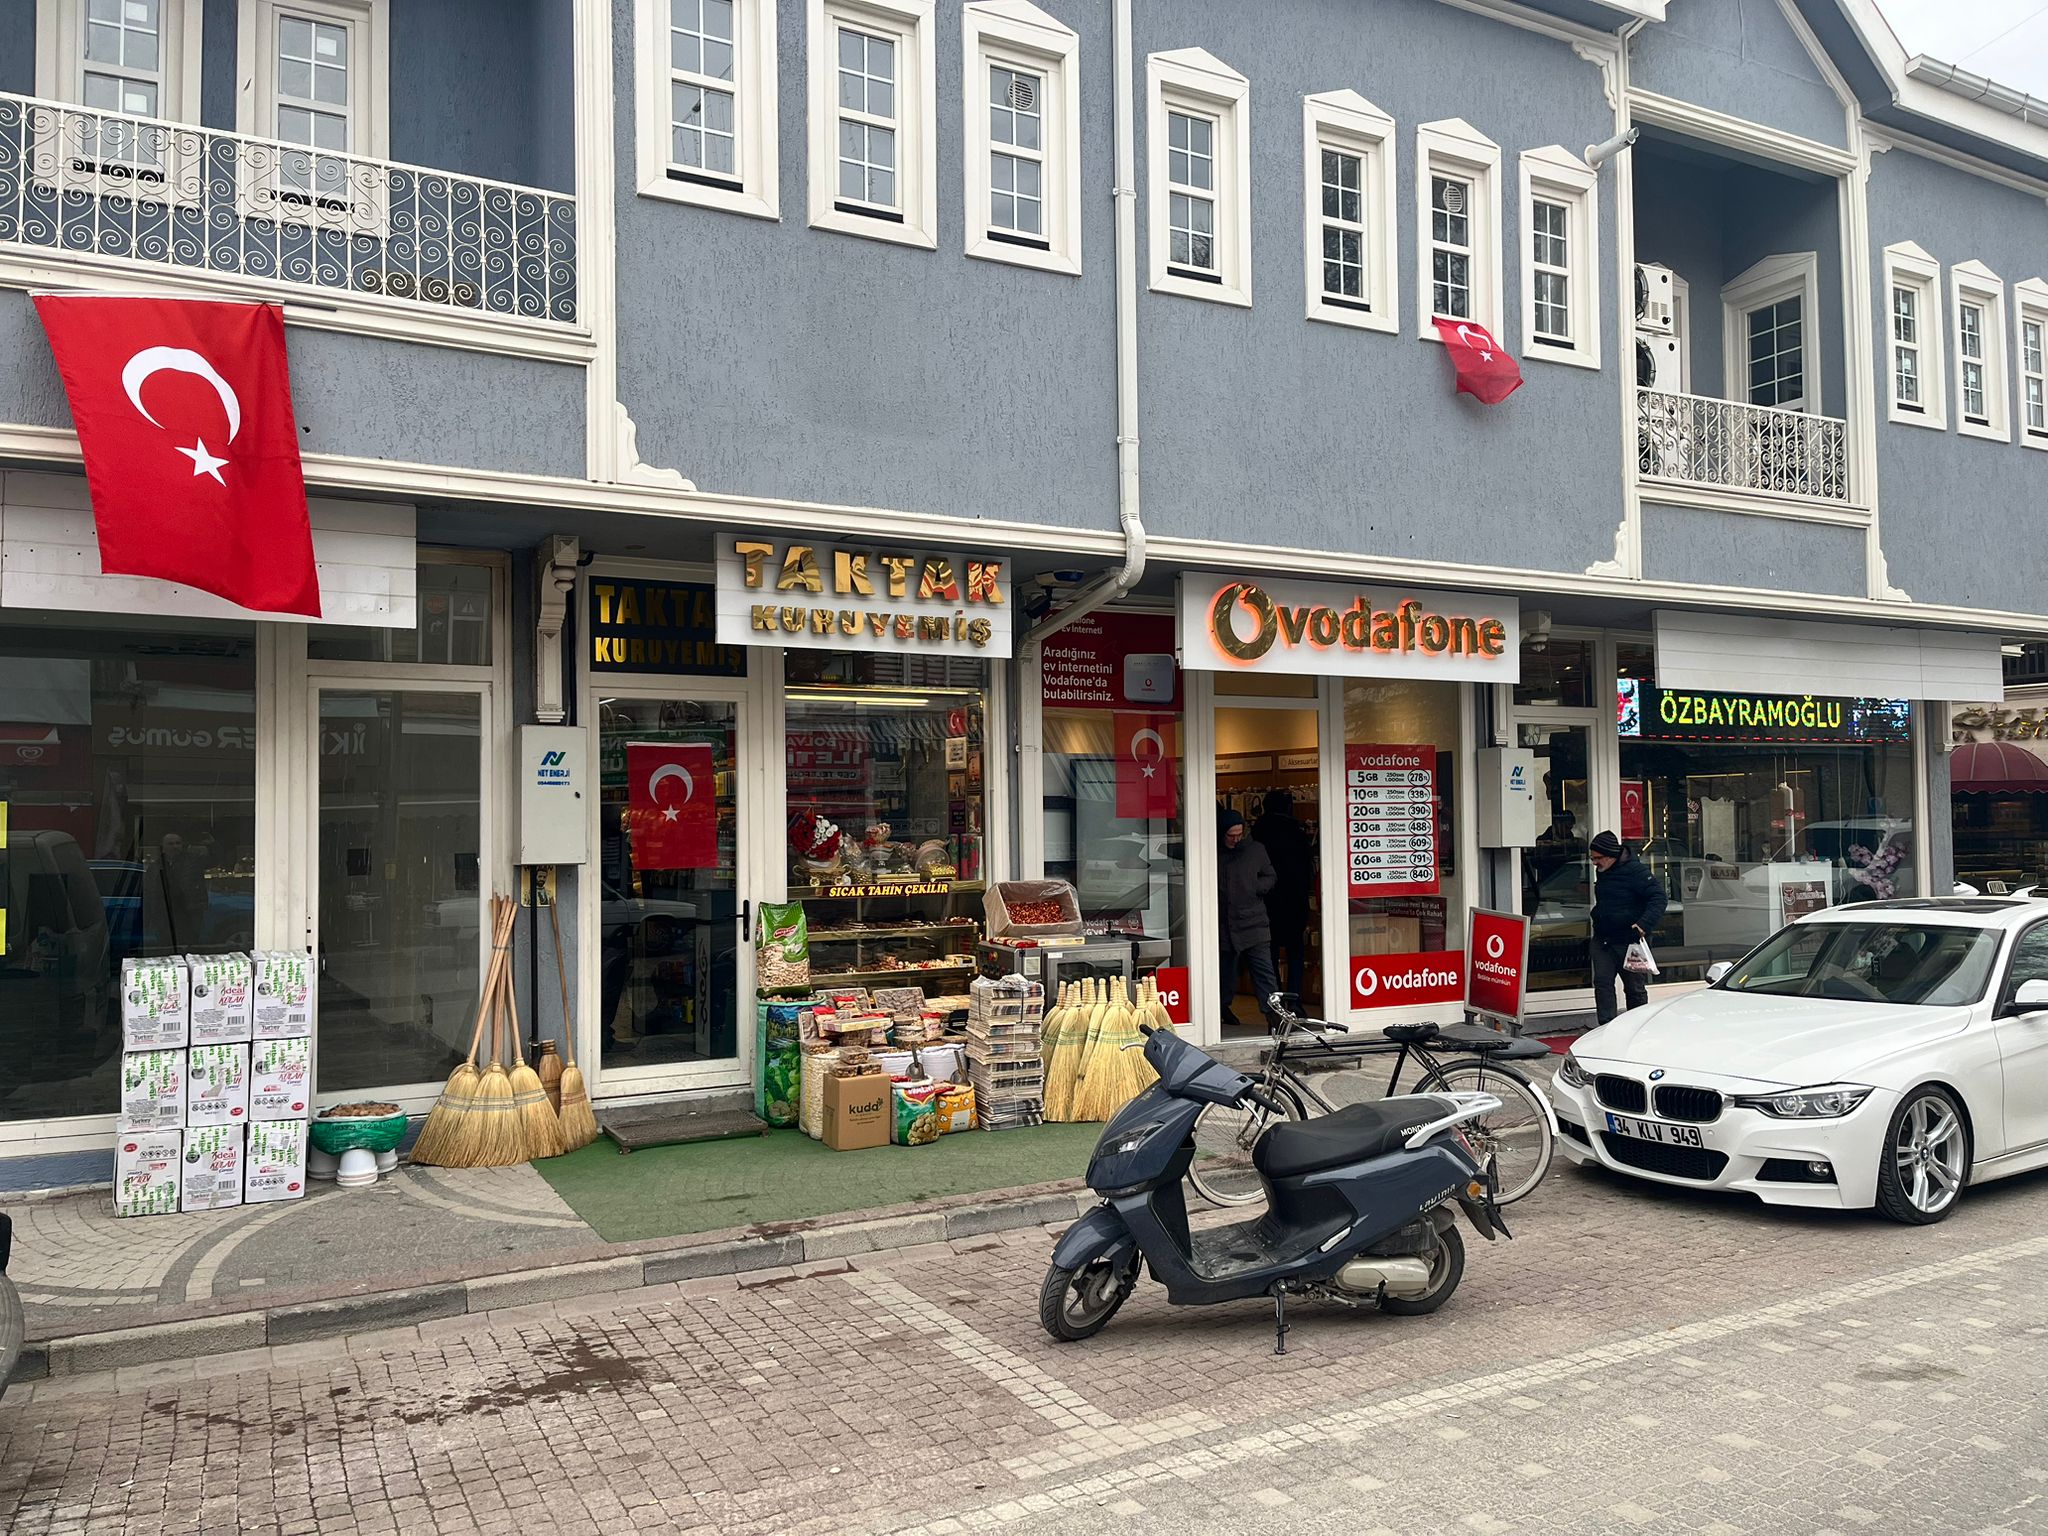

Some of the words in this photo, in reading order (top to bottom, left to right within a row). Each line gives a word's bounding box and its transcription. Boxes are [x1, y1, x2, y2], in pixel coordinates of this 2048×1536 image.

[735, 540, 1005, 604] TAKTAK
[595, 585, 714, 629] TAKTA
[751, 604, 993, 648] KURUYEMİŞ
[1277, 596, 1507, 655] vodafone
[1043, 646, 1096, 661] Aradığınız
[1058, 661, 1113, 674] internetini
[1043, 674, 1108, 688] Vodafone'da
[1043, 688, 1114, 702] bulabilirsiniz.
[1660, 690, 1841, 728] ÖZBAYRAMOĞLU
[1360, 754, 1420, 766] vodafone
[829, 885, 865, 897] SICAK
[868, 883, 902, 896] TAHİN
[905, 882, 949, 896] ÇEKİLİR
[1475, 960, 1517, 977] vodafone
[1382, 968, 1458, 990] vodafone
[1614, 1116, 1630, 1135] 34
[1636, 1122, 1663, 1141] KLV
[1670, 1127, 1699, 1146] 949
